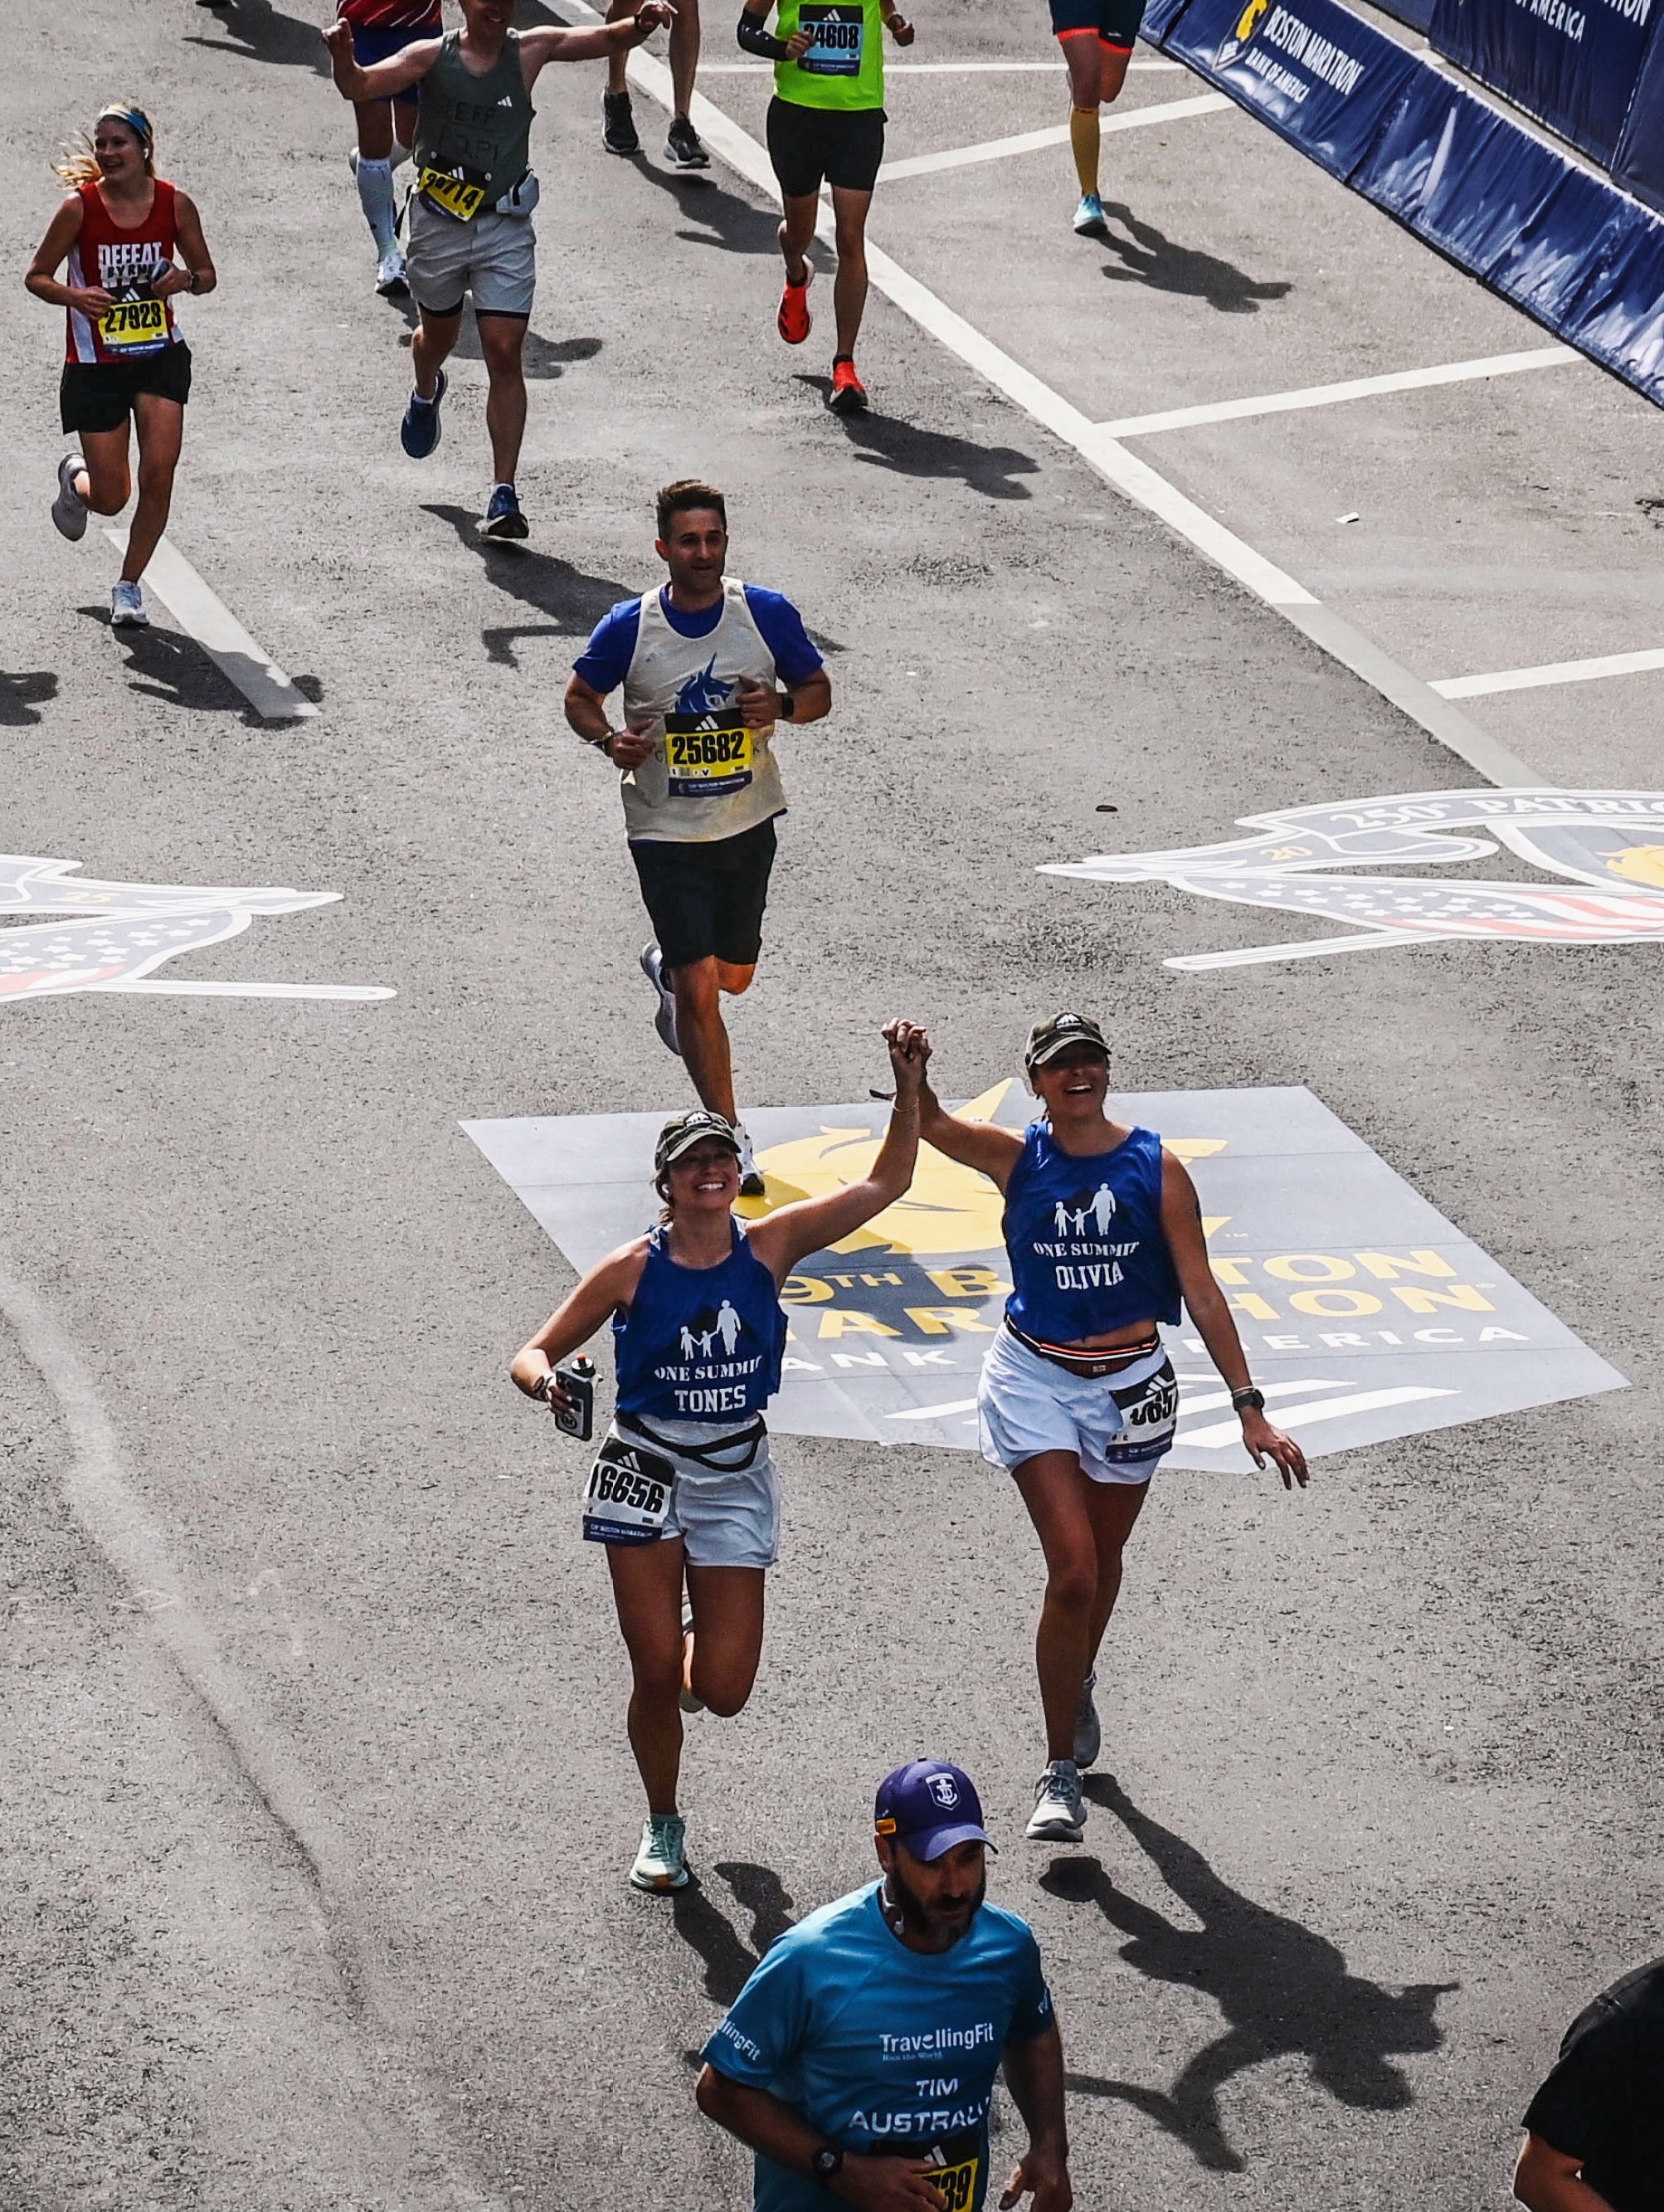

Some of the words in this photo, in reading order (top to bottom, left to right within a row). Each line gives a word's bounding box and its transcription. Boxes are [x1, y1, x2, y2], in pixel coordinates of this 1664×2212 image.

[1244, 47, 1273, 77] BANK
[1263, 5, 1312, 60] BOSTON
[1301, 32, 1365, 95] MARATHON
[1265, 62, 1283, 82] OF
[1273, 71, 1311, 104] AMERICA
[97, 241, 163, 266] DEFEAT
[671, 731, 746, 766] 25682
[1259, 846, 1313, 861] 20
[1033, 1241, 1068, 1258] ONE
[1071, 1241, 1140, 1257] SUMMIT
[1055, 1260, 1125, 1290] OLIVIA
[654, 1365, 690, 1382] ONE
[674, 1384, 747, 1413] TONES
[879, 2022, 995, 2053] TravellingFit
[903, 2052, 917, 2061] the
[916, 2078, 959, 2098] TIM
